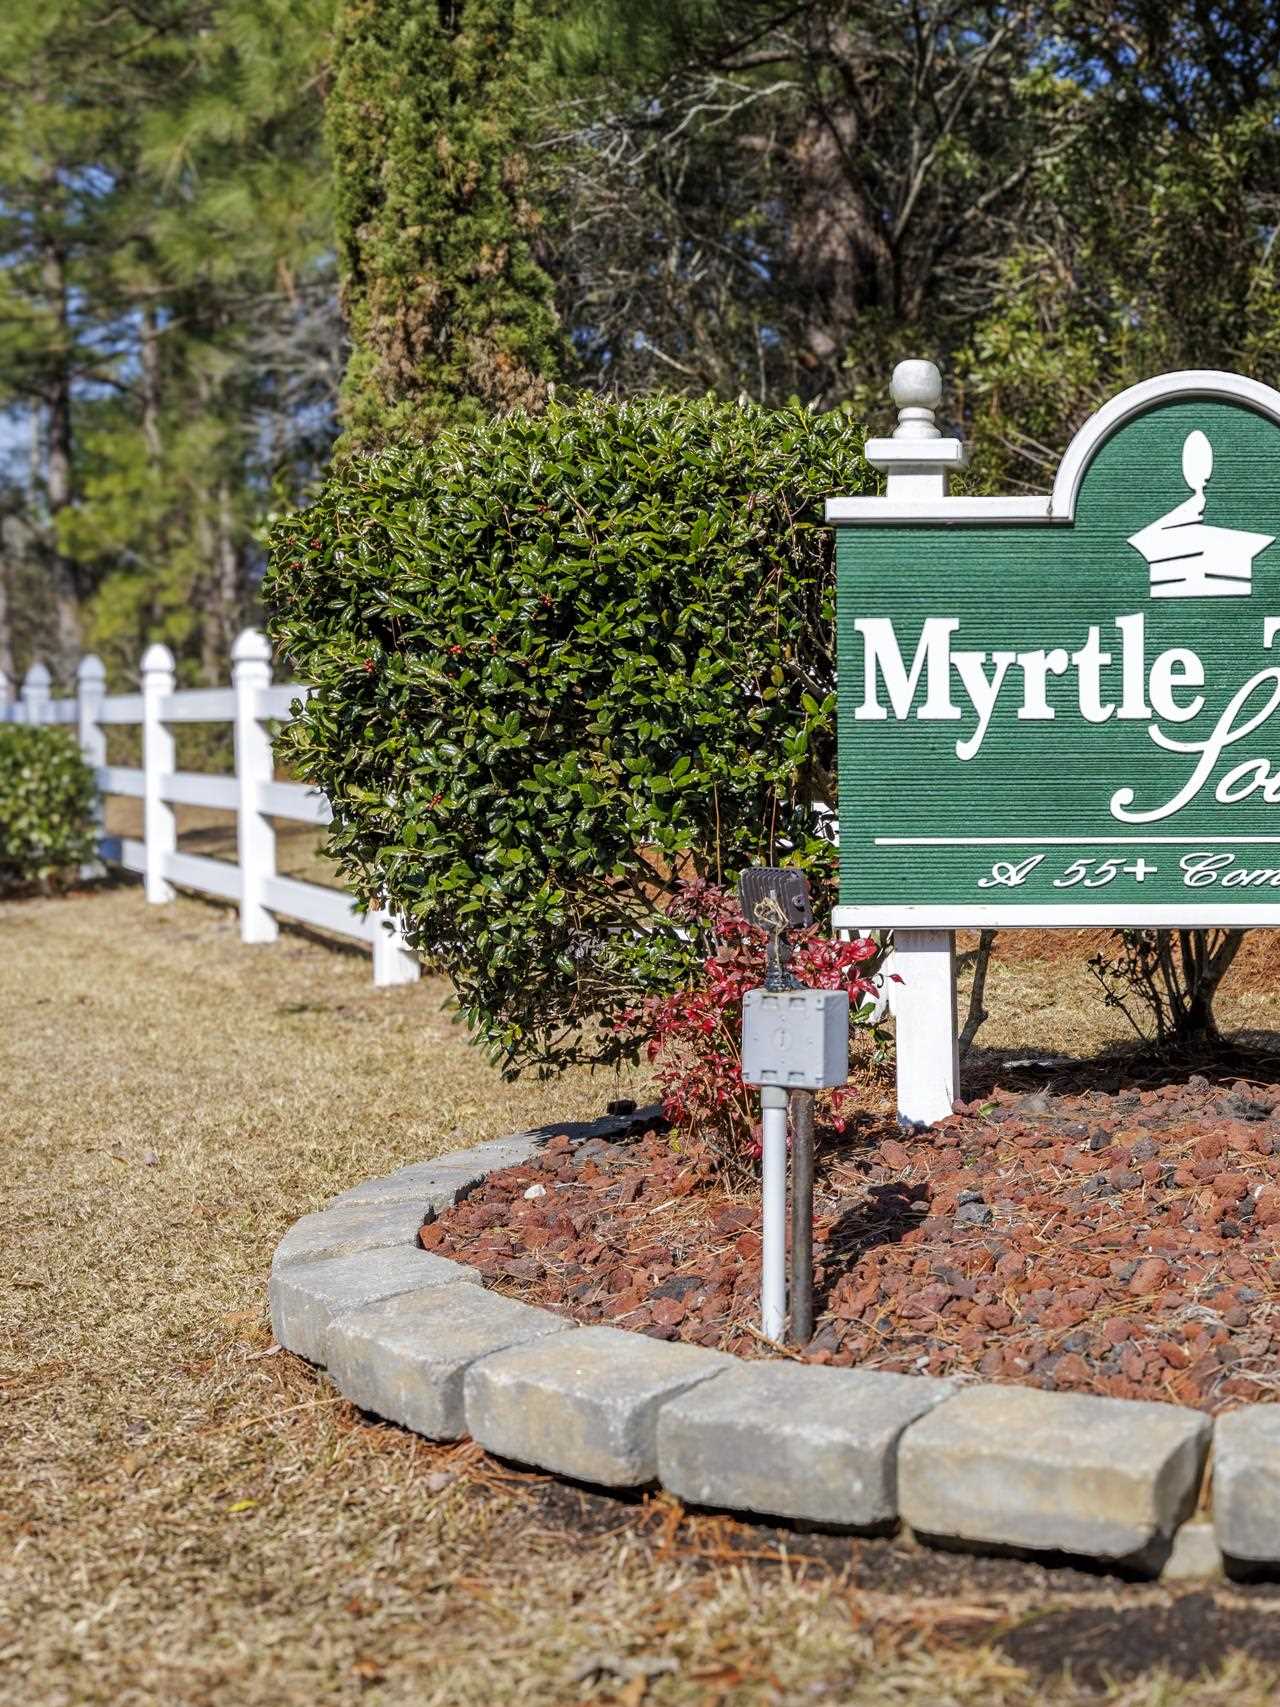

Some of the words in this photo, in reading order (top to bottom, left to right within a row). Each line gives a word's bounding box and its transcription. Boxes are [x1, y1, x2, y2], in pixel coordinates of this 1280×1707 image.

[854, 612, 1206, 762] Myrtle
[977, 853, 1046, 888] A
[1053, 857, 1158, 887] 55+
